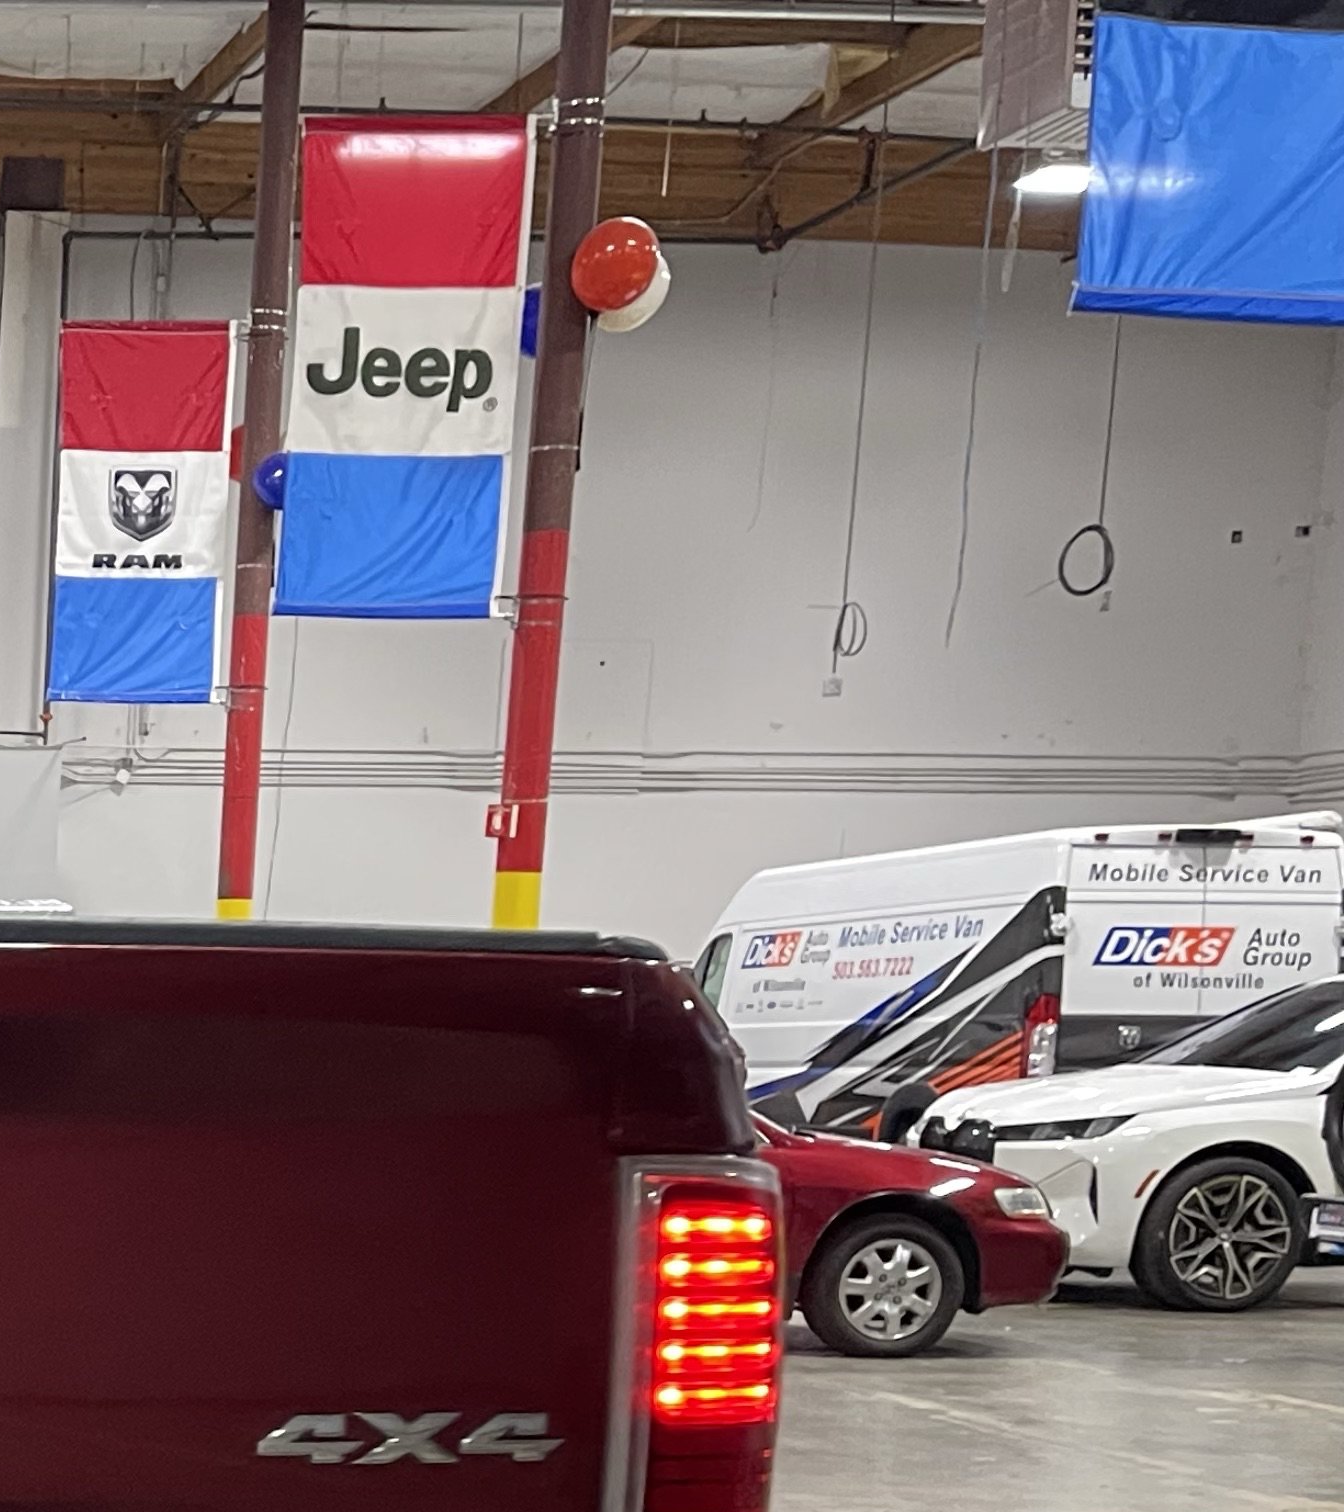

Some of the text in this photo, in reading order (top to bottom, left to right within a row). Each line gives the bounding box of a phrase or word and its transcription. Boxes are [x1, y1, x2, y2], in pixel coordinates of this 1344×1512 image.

[306, 327, 493, 413] Jeep
[92, 553, 183, 570] RAM
[1088, 864, 1321, 883] Mobile Service Van
[838, 915, 984, 947] Mobile Service Van
[1248, 928, 1300, 946] Auto
[1100, 929, 1224, 963] Dick's
[1243, 947, 1312, 970] Group
[1133, 973, 1264, 989] of Wilsonville
